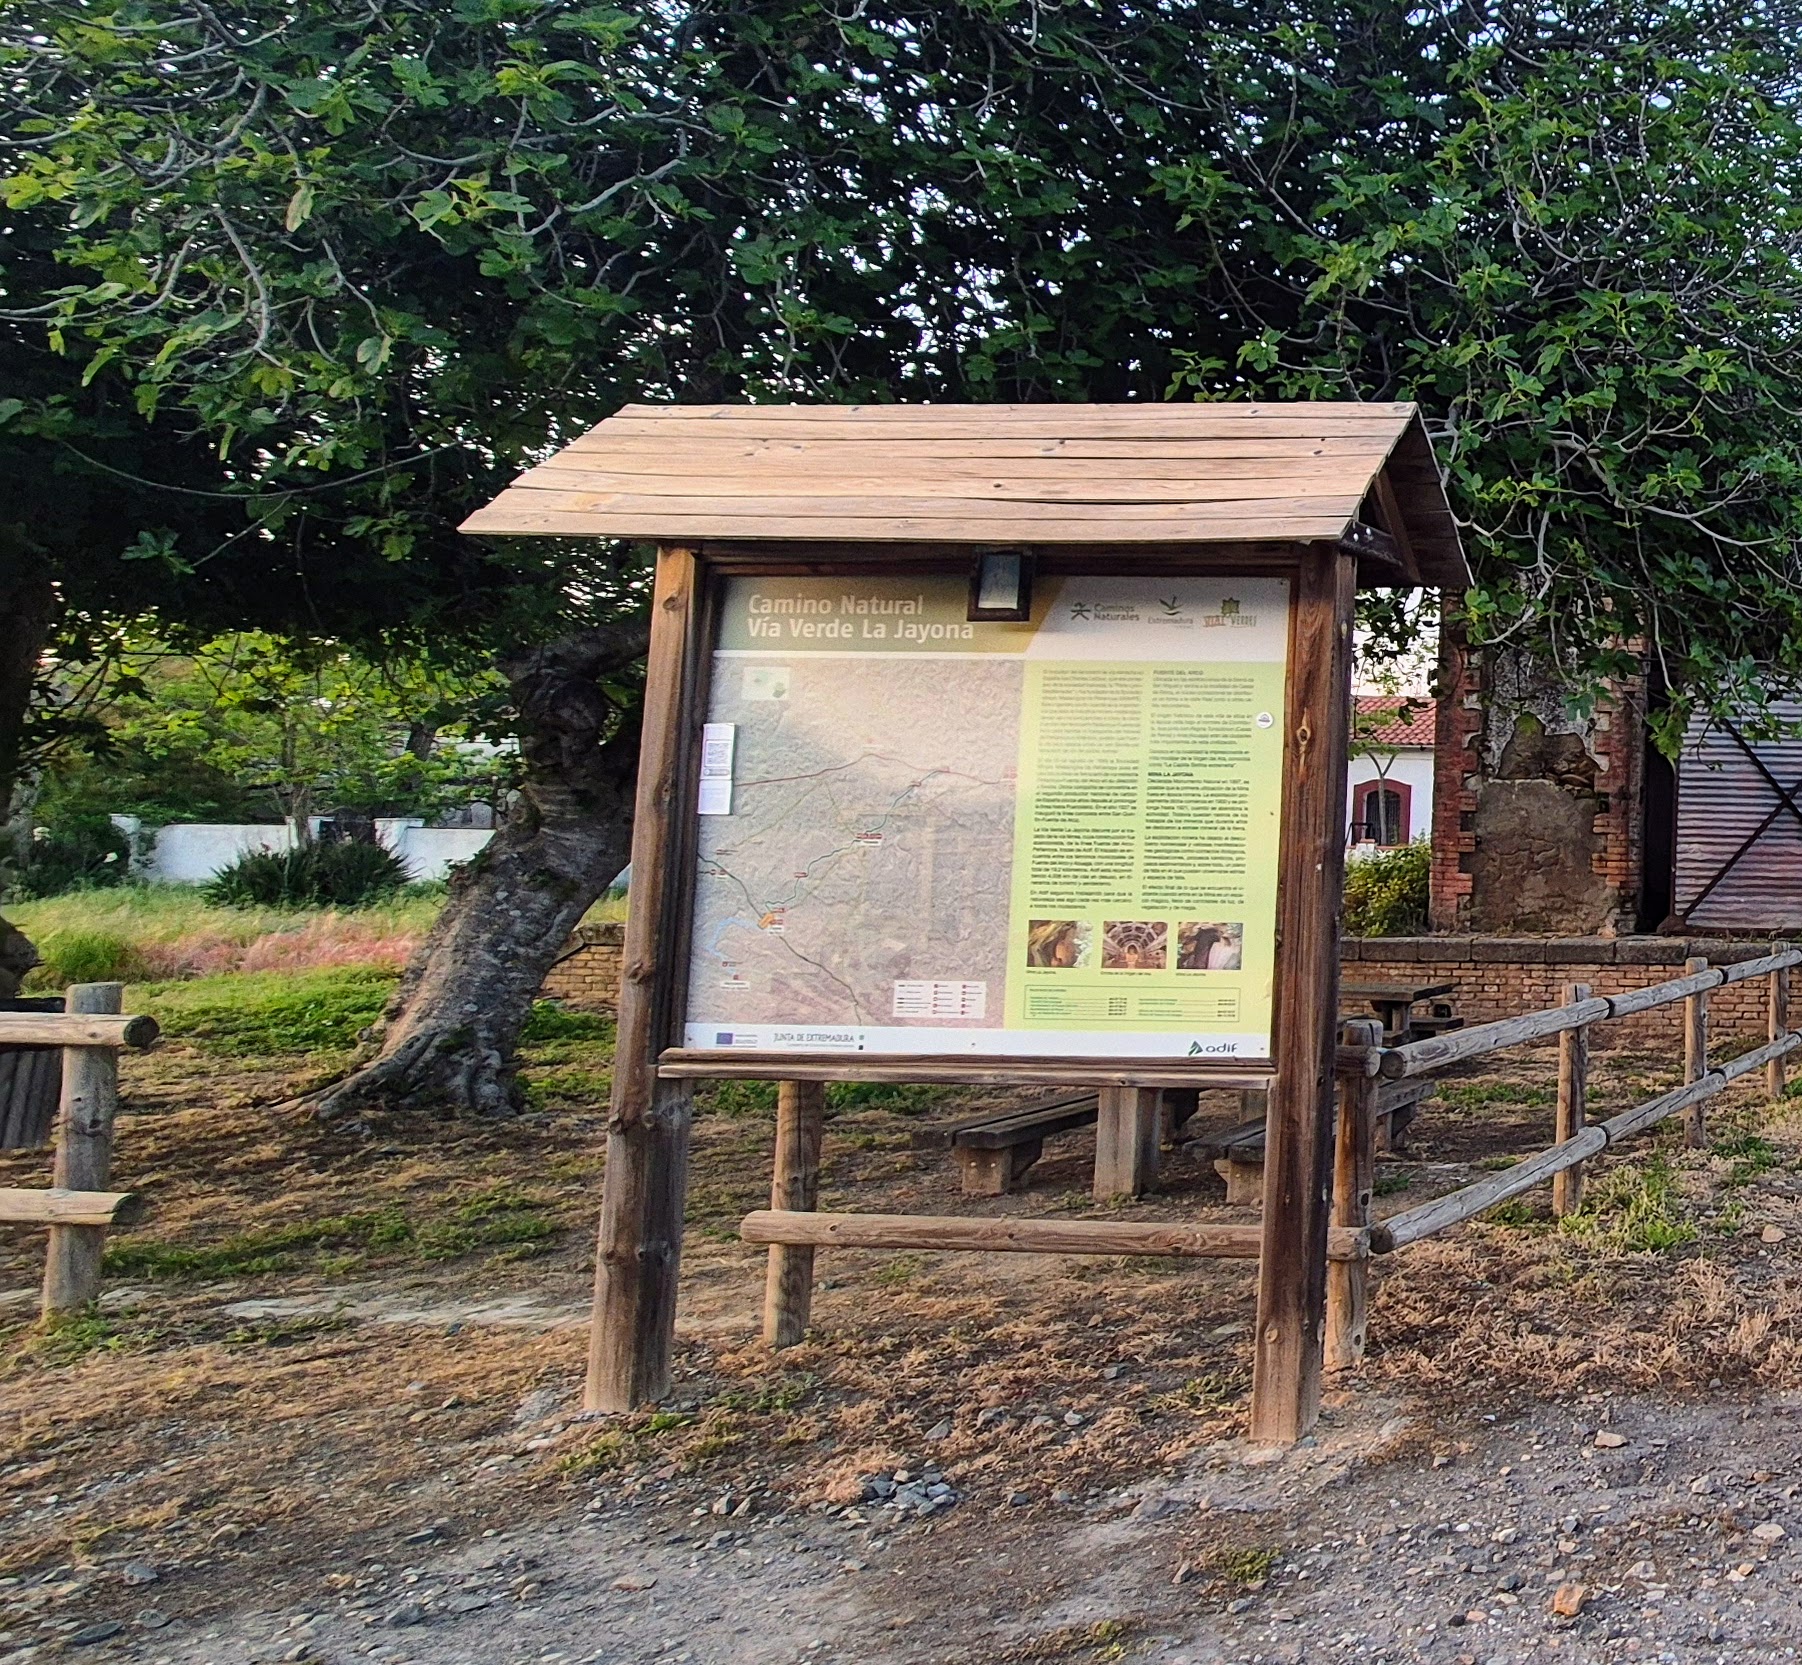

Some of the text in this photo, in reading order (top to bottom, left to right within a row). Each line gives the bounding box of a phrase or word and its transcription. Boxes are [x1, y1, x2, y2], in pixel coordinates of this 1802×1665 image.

[749, 594, 923, 615] Camino Natural
[1094, 603, 1135, 613] Caminos
[1094, 612, 1140, 622] Naturales
[748, 616, 974, 644] Vía Verde La Jayona
[774, 1033, 855, 1042] JUNTA DE EXTREMADURA
[1205, 1042, 1238, 1053] adif
